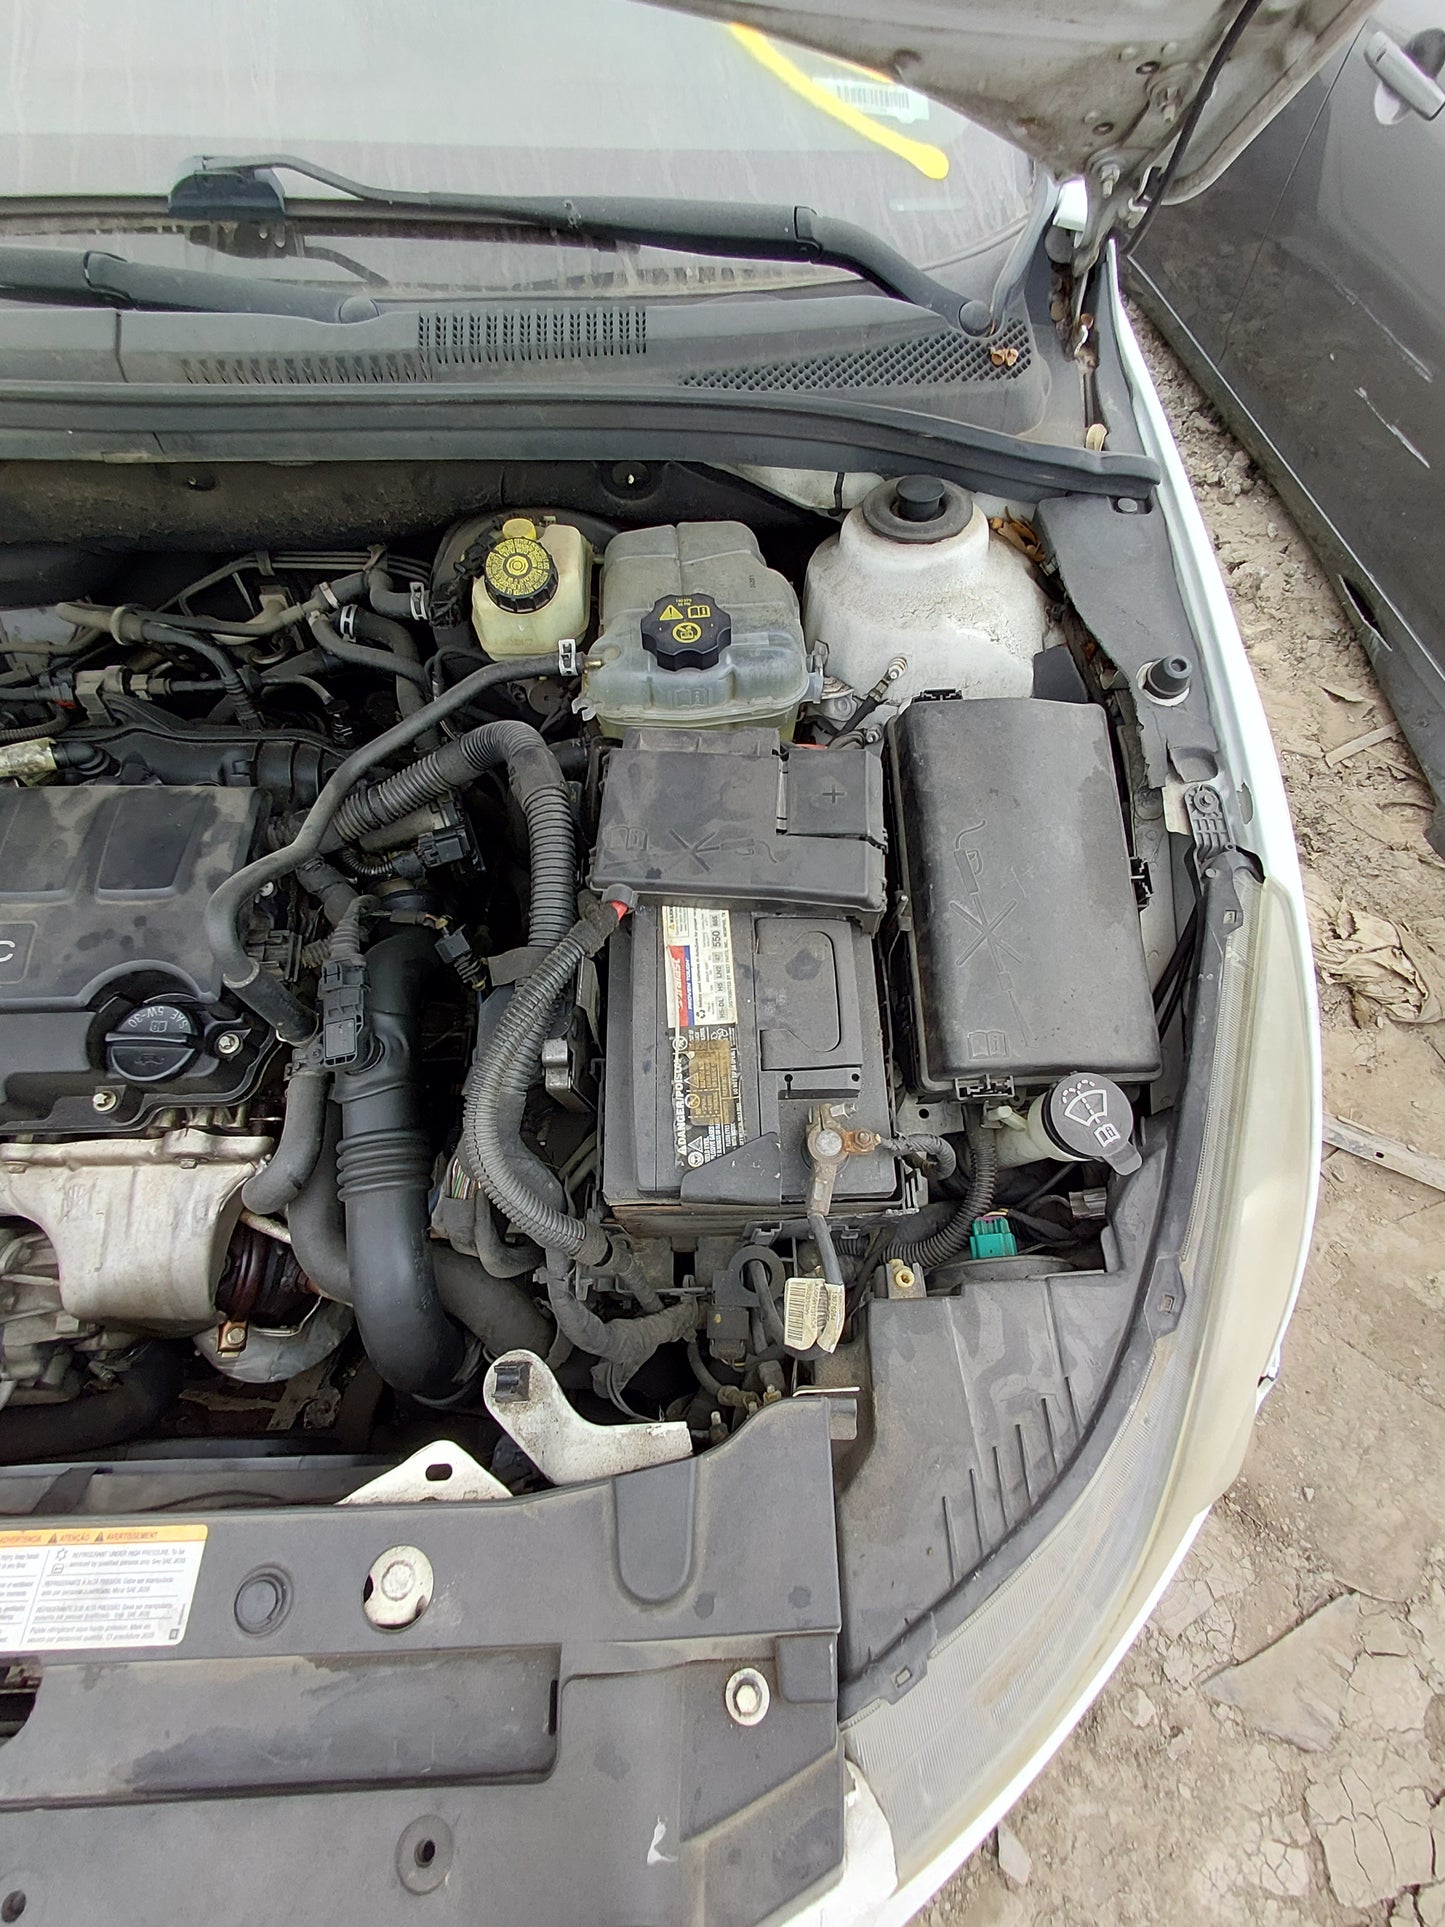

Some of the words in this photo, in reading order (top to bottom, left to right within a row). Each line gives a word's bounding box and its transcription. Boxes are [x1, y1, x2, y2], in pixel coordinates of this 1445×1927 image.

[712, 930, 721, 947] 550
[716, 982, 723, 991] H5
[128, 1006, 164, 1027] 5W-30
[717, 998, 725, 1018] H5-DL
[169, 1010, 188, 1029] SAE
[60, 1532, 91, 1542] ATENÇÃO
[106, 1531, 158, 1540] AVERTISSEMENT
